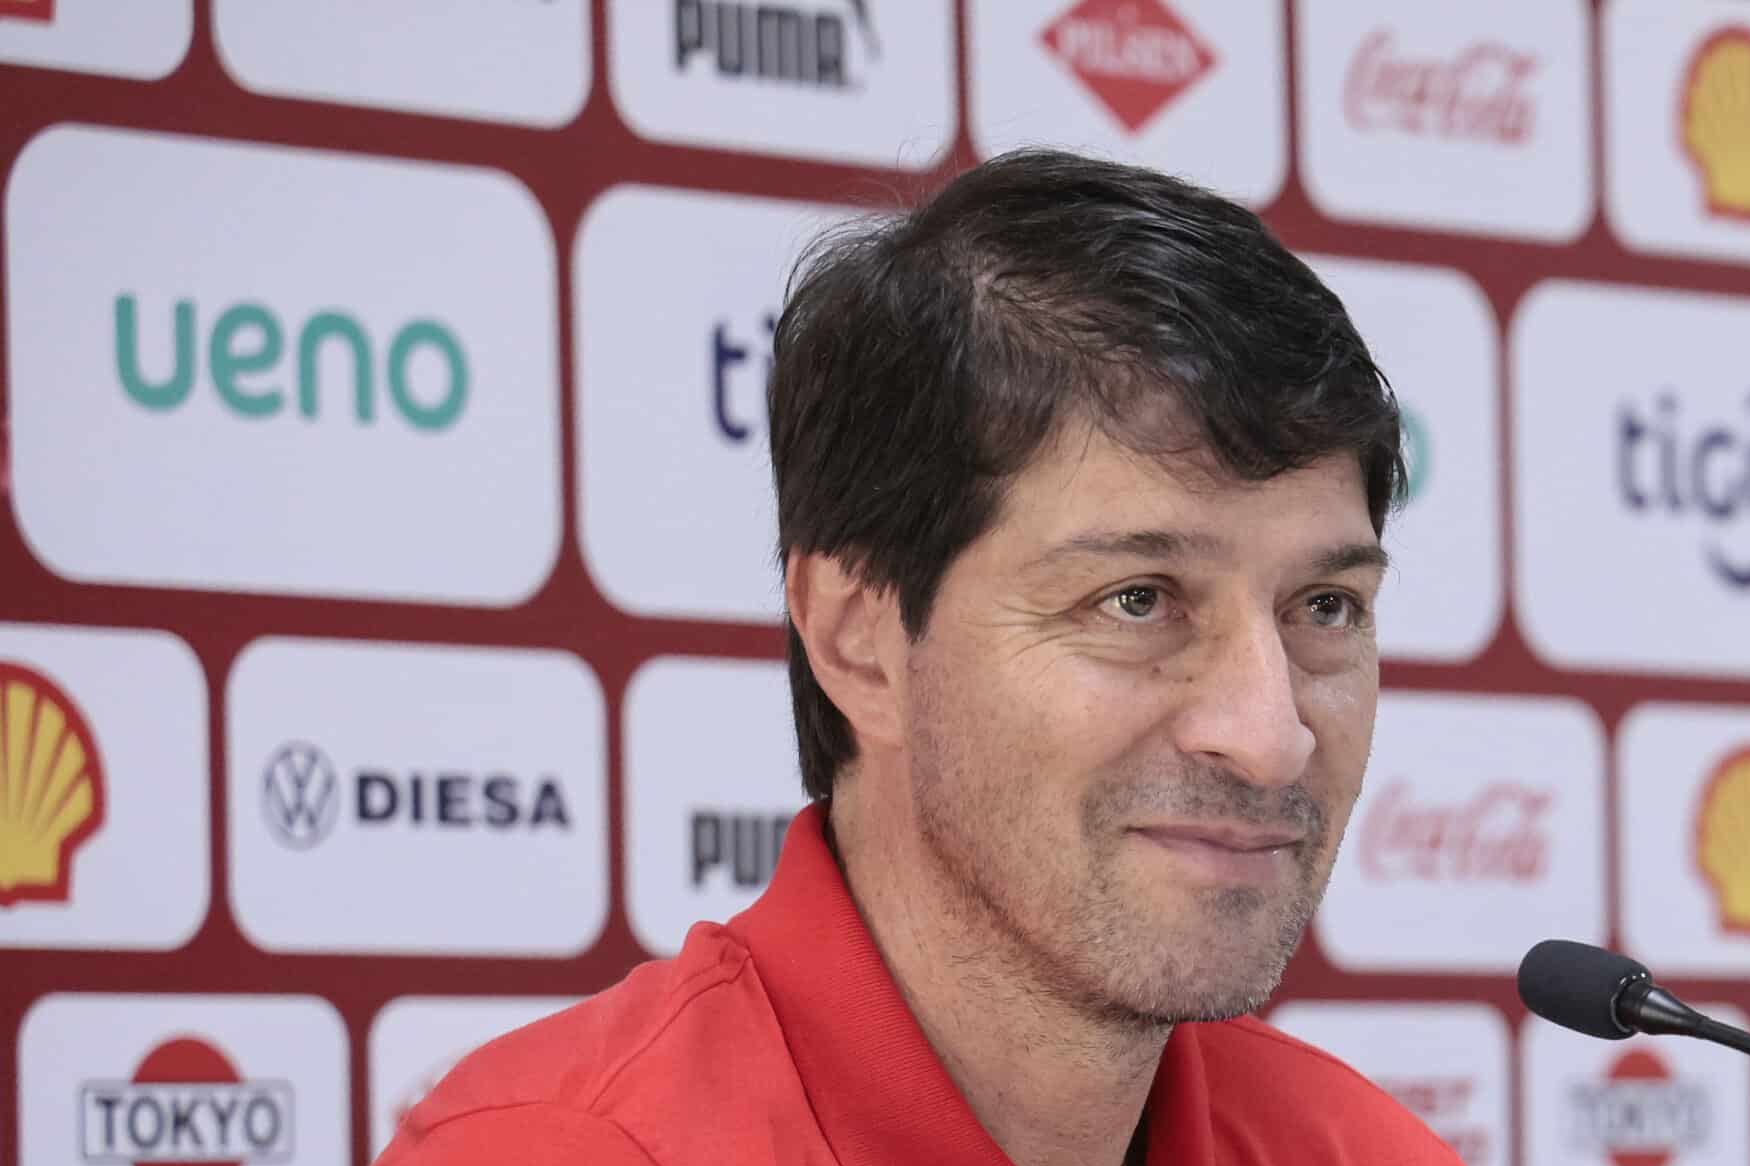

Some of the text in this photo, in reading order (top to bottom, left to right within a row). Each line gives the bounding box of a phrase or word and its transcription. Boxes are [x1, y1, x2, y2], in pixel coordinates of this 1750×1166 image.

[672, 0, 848, 86] PUMA
[114, 293, 471, 430] ueno
[356, 772, 571, 830] DIESA
[692, 812, 790, 886] PU
[93, 1094, 284, 1152] TOKYO
